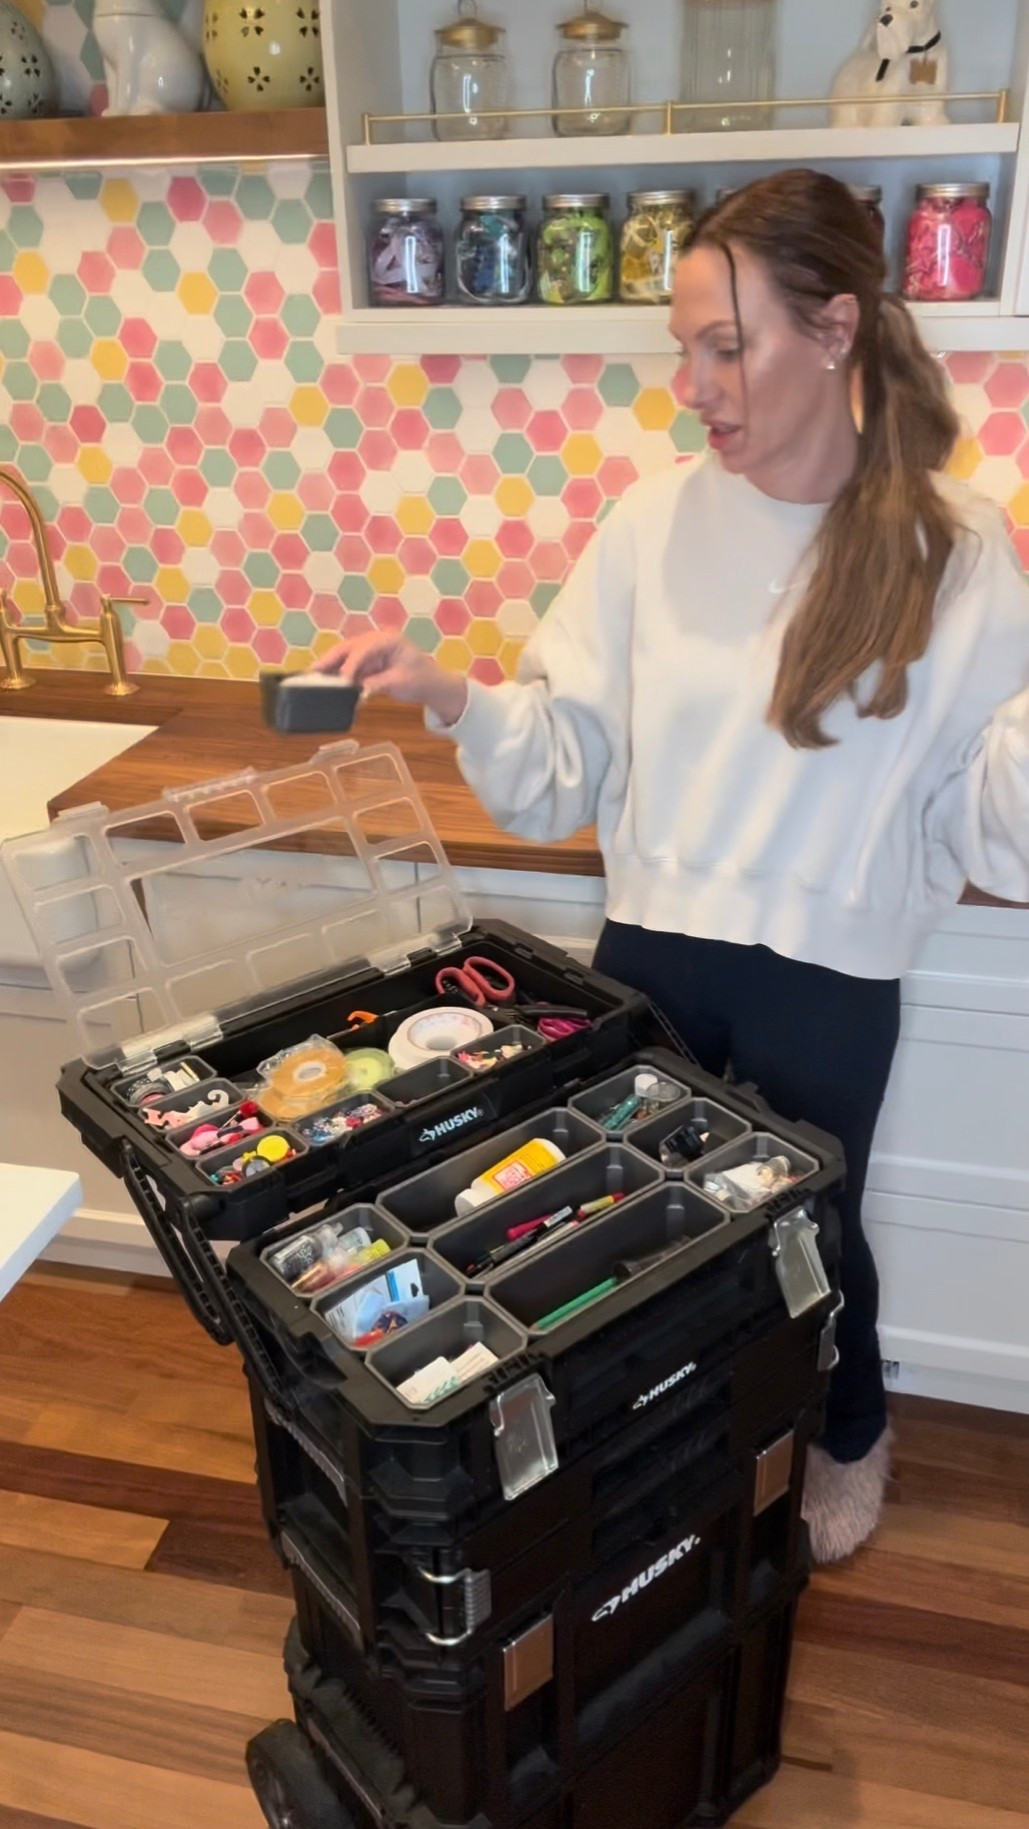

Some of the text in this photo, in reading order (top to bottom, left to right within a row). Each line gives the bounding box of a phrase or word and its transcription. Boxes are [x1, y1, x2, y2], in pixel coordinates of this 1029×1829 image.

[434, 1107, 478, 1136] HUSKY
[649, 1362, 693, 1400] HUSKY
[621, 1534, 695, 1603] HUSKY
